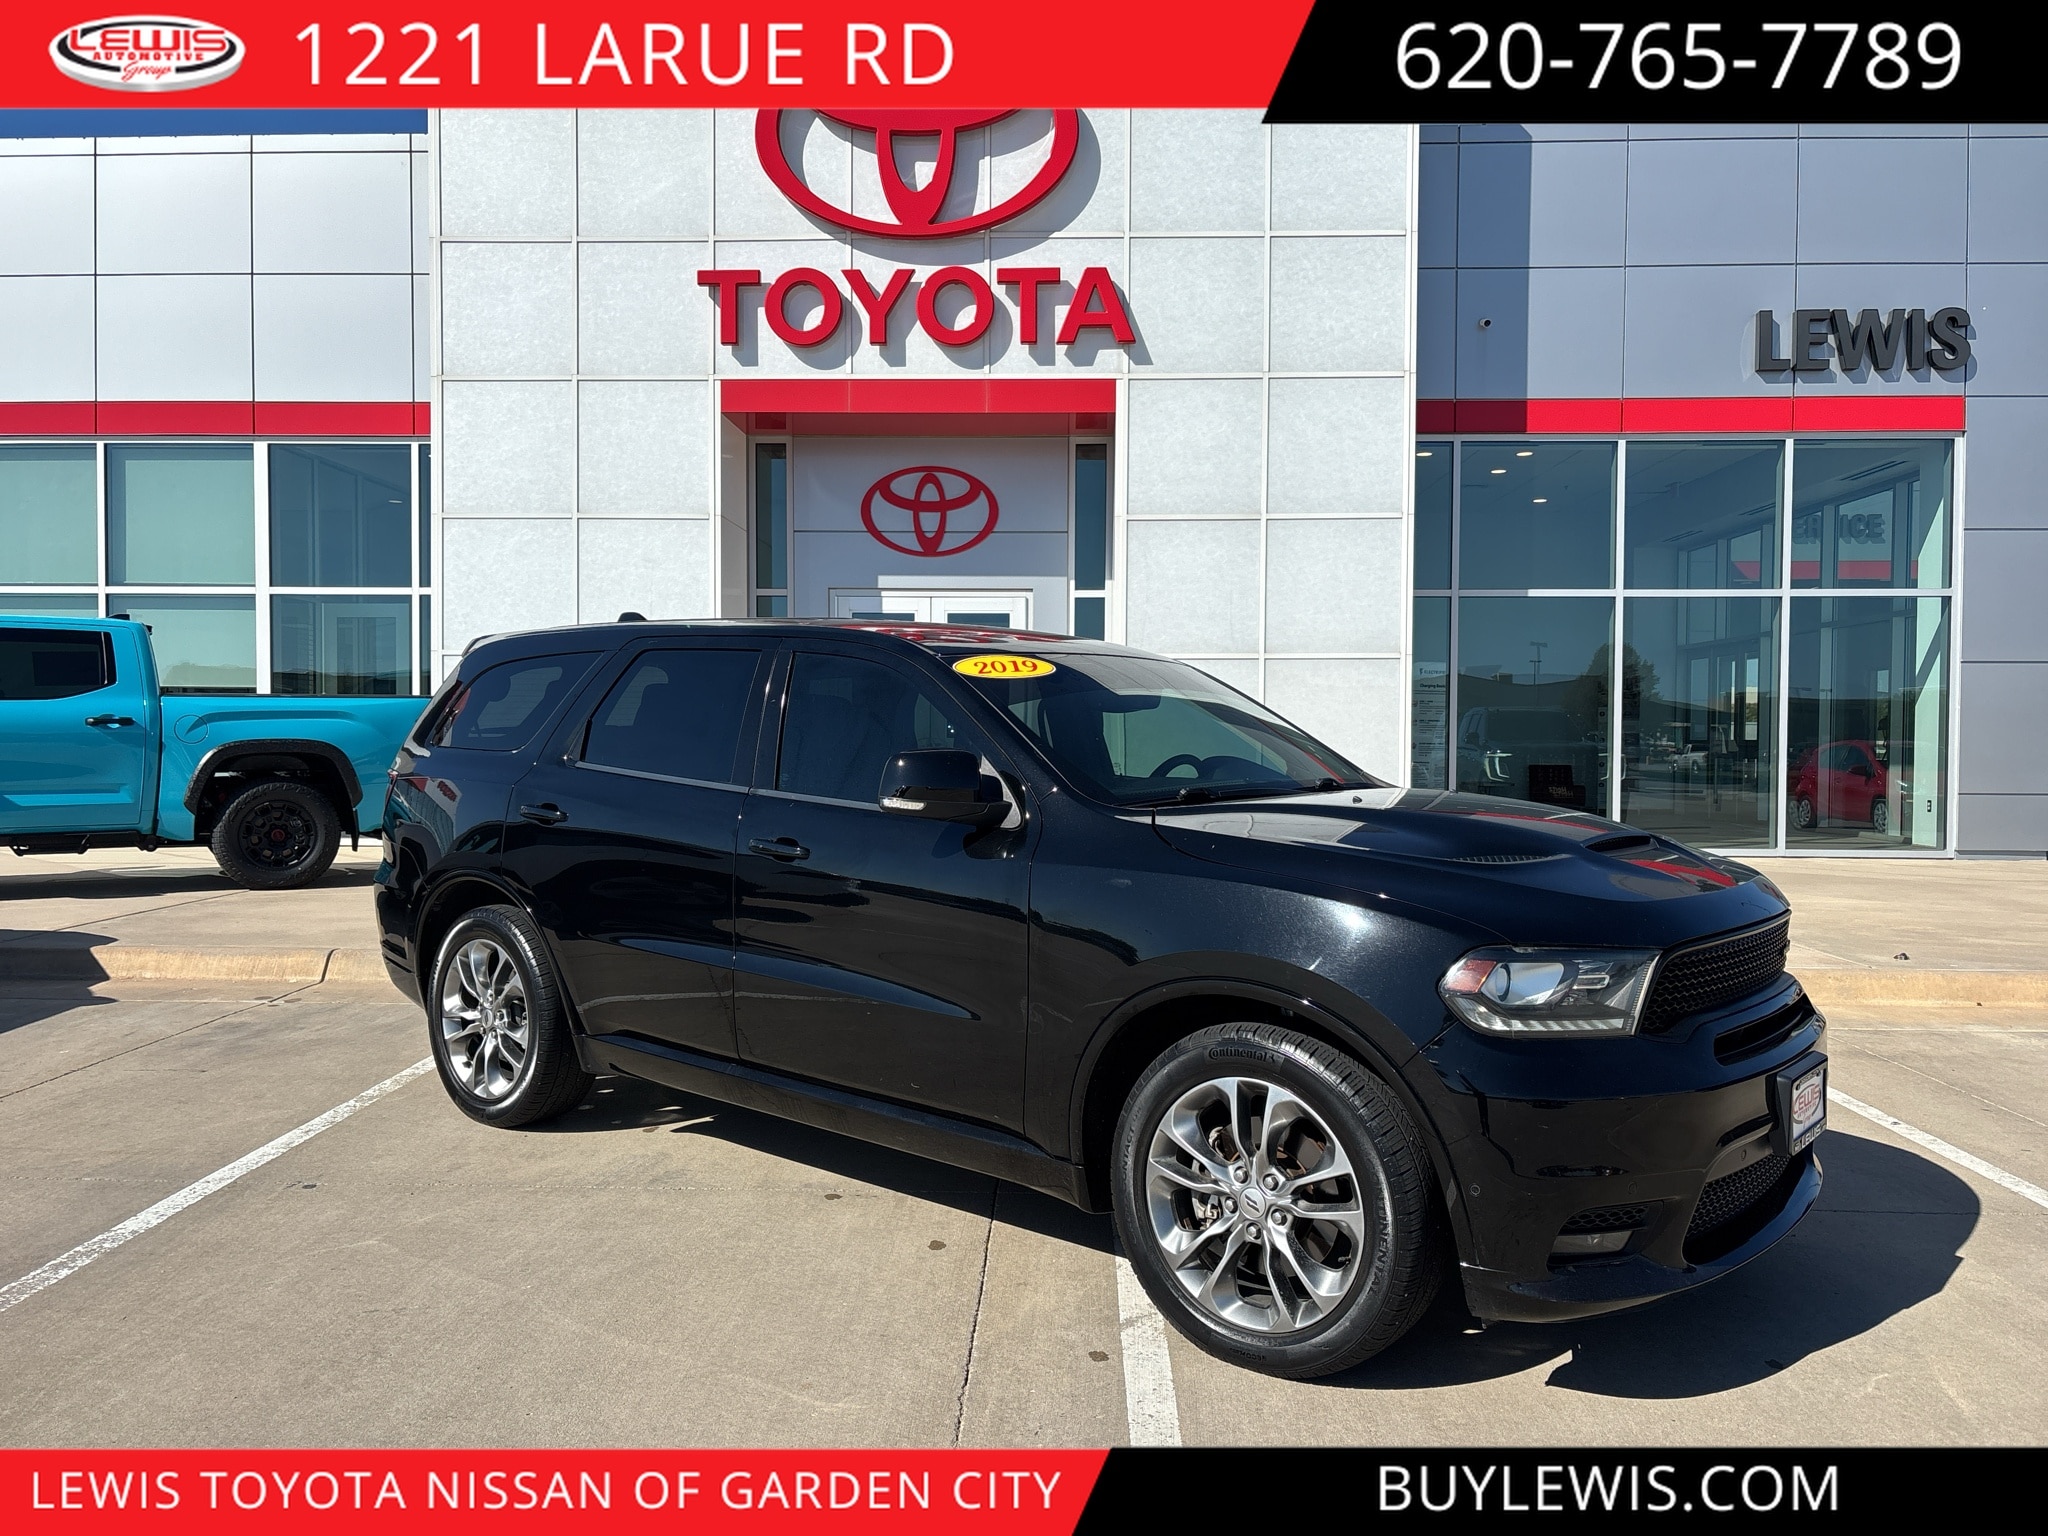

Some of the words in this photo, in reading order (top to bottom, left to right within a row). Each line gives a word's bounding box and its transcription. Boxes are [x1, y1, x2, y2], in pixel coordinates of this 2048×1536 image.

[697, 266, 1137, 346] TOYOTA
[1755, 307, 1972, 372] LEWIS
[973, 660, 1038, 675] 2019
[1208, 1046, 1268, 1062] Continental
